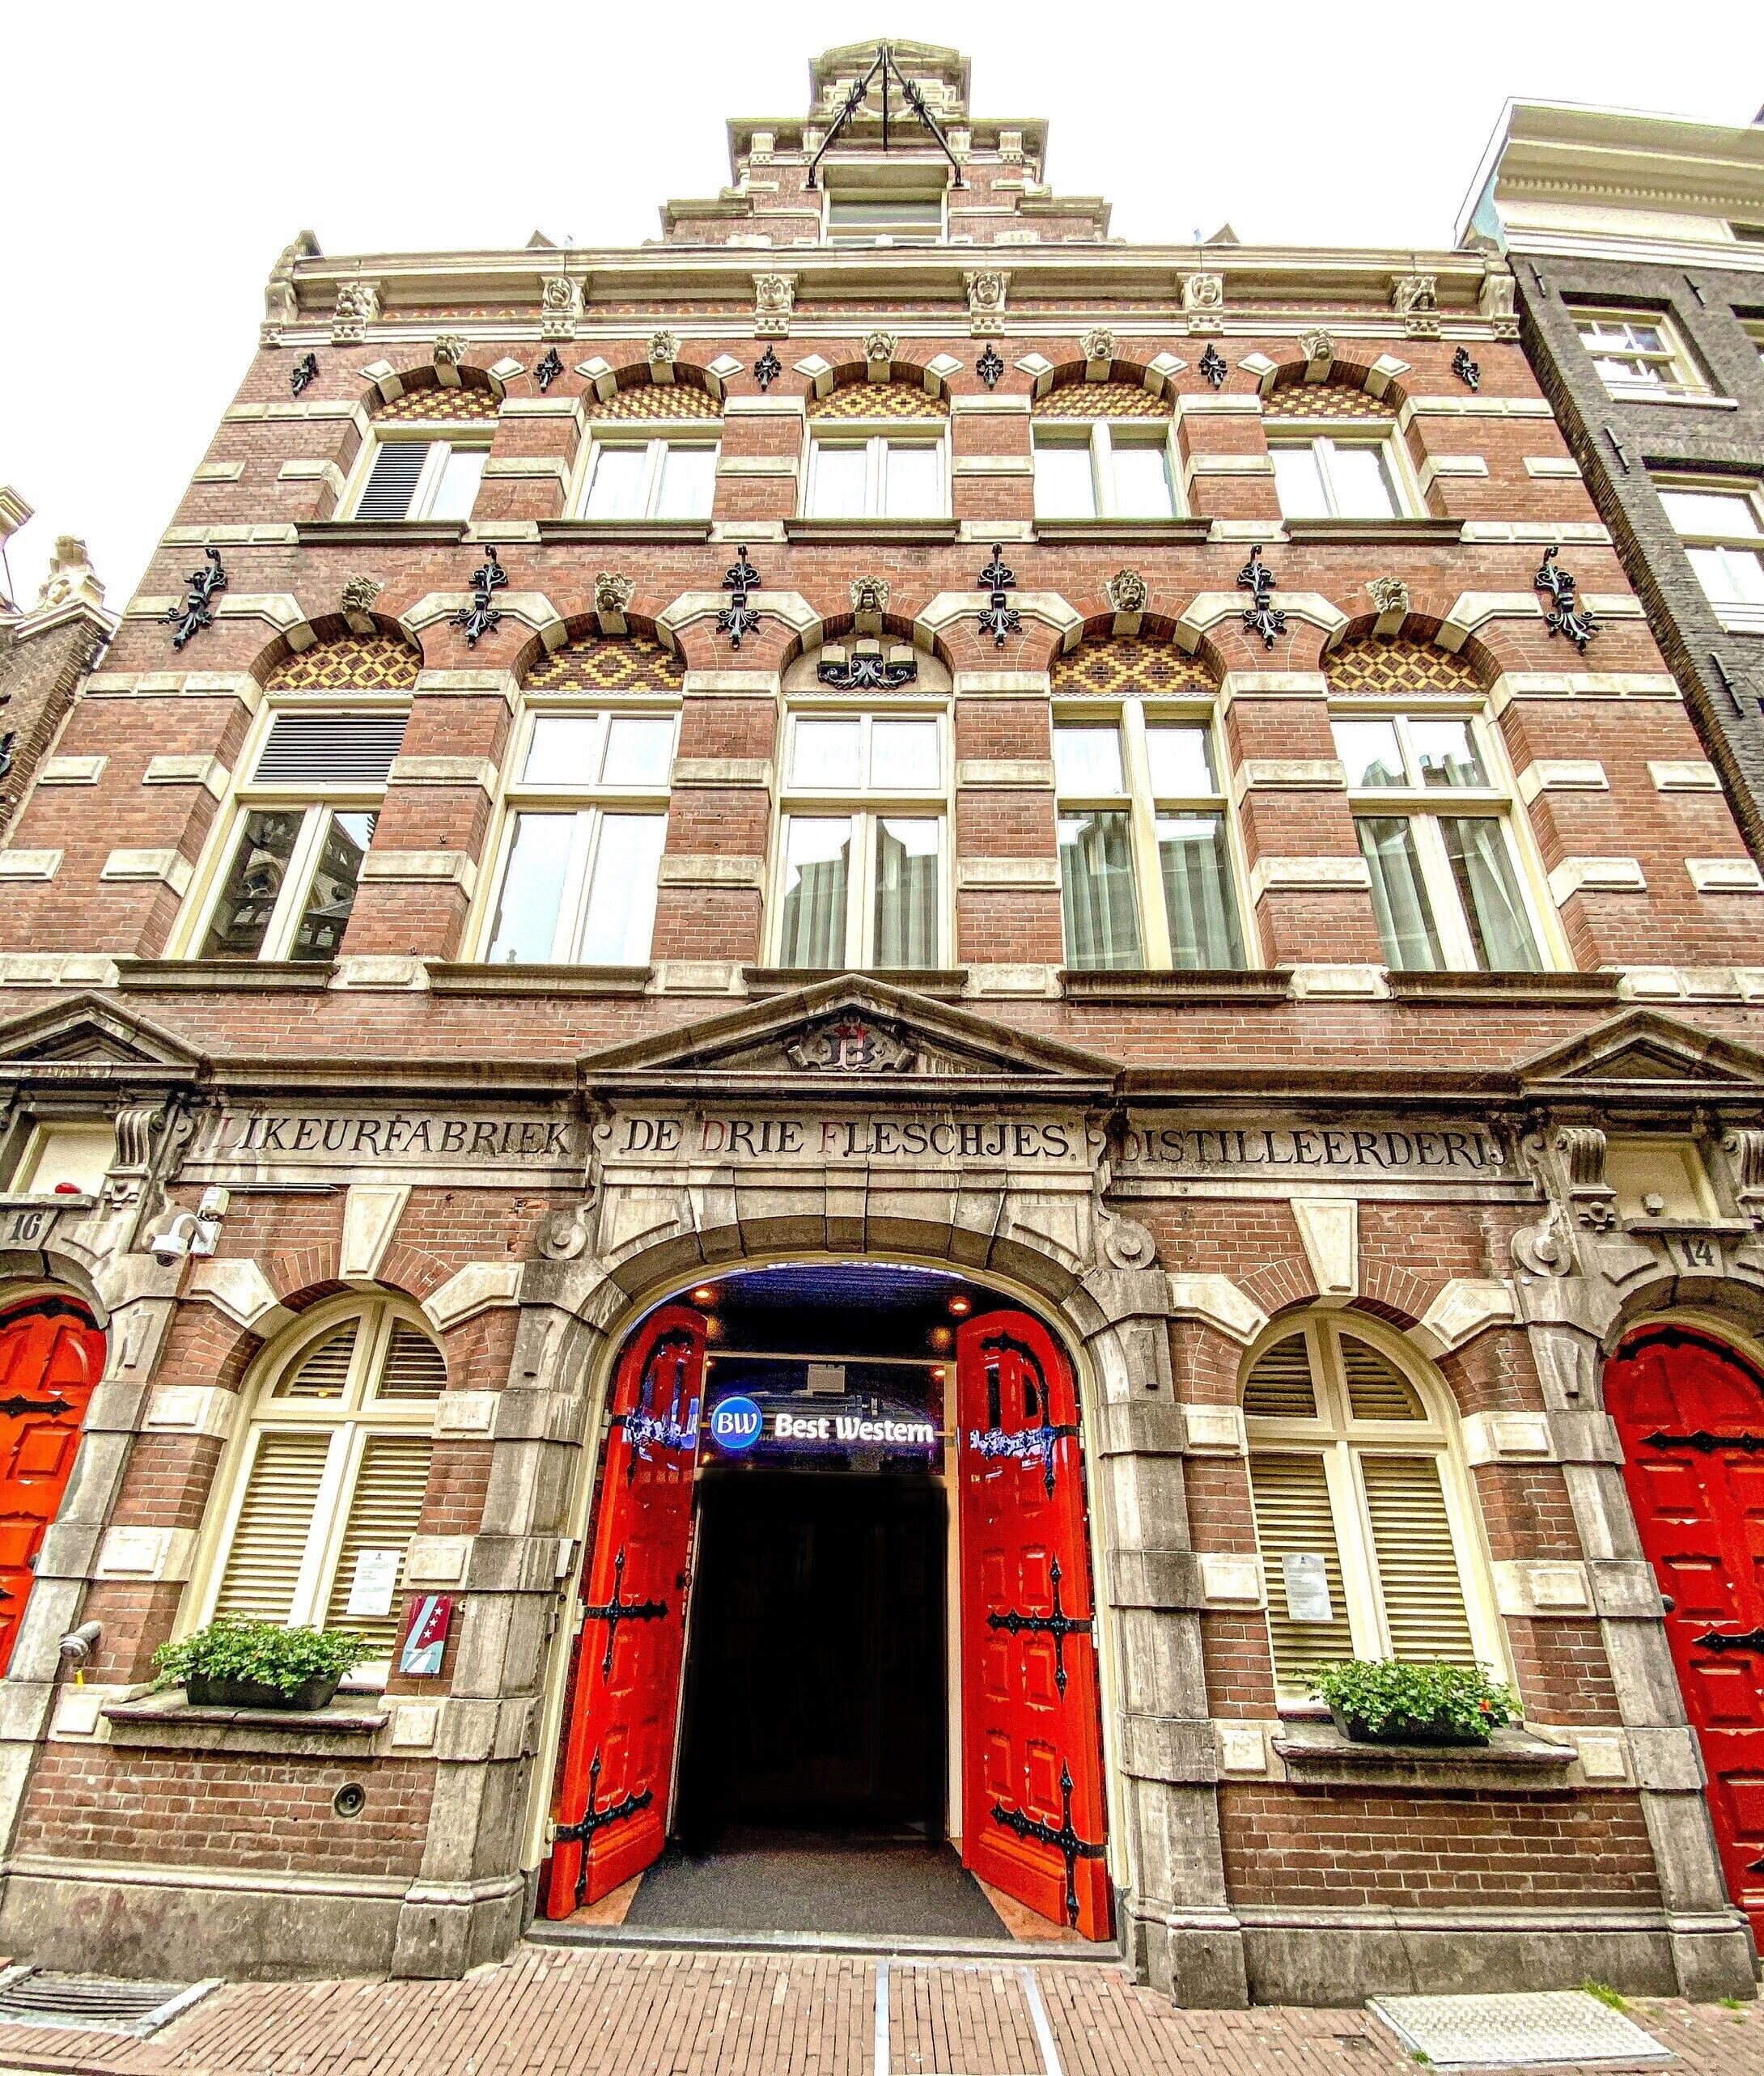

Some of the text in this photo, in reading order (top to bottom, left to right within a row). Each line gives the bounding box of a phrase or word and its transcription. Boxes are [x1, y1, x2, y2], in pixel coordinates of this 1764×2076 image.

[212, 1117, 573, 1157] LIKEURFABRIEK
[624, 1118, 1069, 1158] DE DRIE FLESCHJES
[1116, 1129, 1506, 1170] DISTILLEERDERIJ
[8, 1213, 42, 1240] 16
[1681, 1239, 1715, 1267] 14
[717, 1412, 935, 1443] BW Best Western
